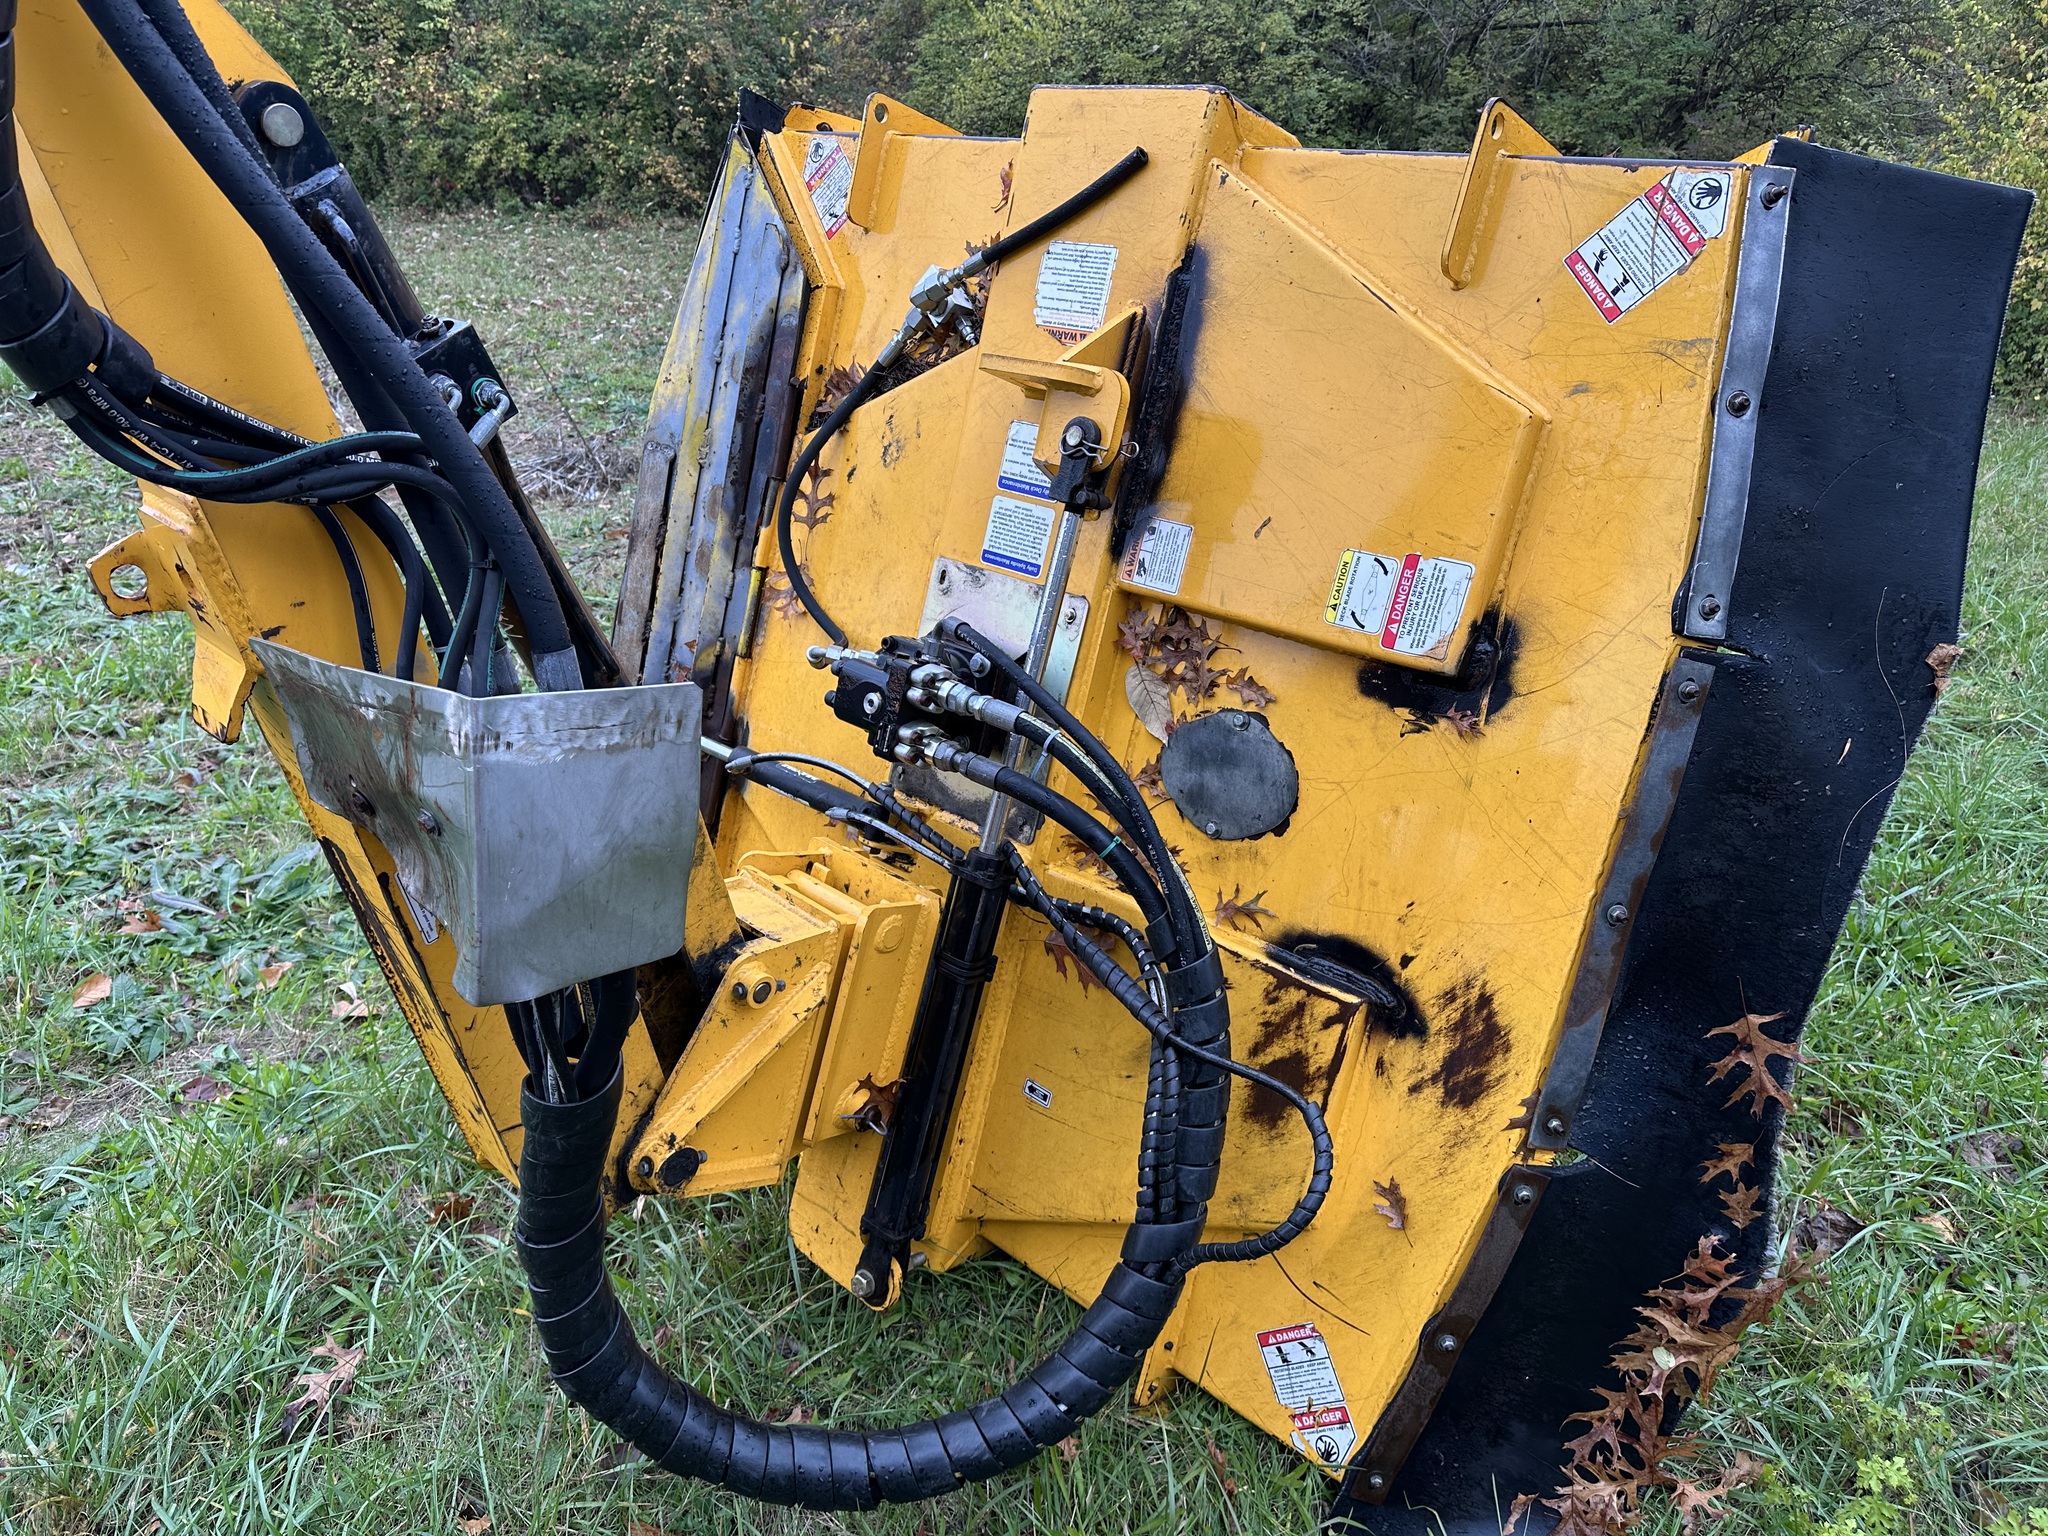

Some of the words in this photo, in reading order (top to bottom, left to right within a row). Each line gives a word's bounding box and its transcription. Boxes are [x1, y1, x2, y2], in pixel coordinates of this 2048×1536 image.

[1652, 190, 1691, 236] DANGER
[1682, 202, 1690, 212] AND
[1688, 210, 1700, 224] HANDS
[1697, 222, 1708, 234] KEEP
[1603, 232, 1613, 245] AWAY
[1610, 243, 1620, 255] KEEP
[1620, 255, 1633, 271] BLADES
[1573, 261, 1606, 301] DANGER
[1630, 269, 1646, 288] ROTATING
[85, 387, 110, 411] MPa
[168, 379, 206, 403] Parker
[209, 399, 245, 420] TOUGH
[246, 416, 275, 433] COVER
[129, 425, 149, 443] WP
[1001, 477, 1030, 490] Maintenance
[1030, 485, 1042, 493] Deck
[983, 552, 1010, 565] Maintenance
[1010, 560, 1026, 569] Spindle
[1026, 564, 1037, 573] Daily
[1332, 560, 1349, 601] CAUTION
[1338, 605, 1347, 621] DECK
[1343, 585, 1353, 605] BLADE
[1348, 555, 1361, 585] ROTATION
[1410, 567, 1424, 597] SERIOUS
[1391, 568, 1414, 619] DANGER
[1400, 598, 1414, 629] PREVENT
[1405, 612, 1417, 636] INJURY
[1413, 600, 1421, 611] OR
[1408, 637, 1416, 648] When
[1412, 617, 1422, 636] changing
[1425, 580, 1433, 595] always
[1397, 629, 1405, 639] TO
[1147, 842, 1169, 893] HANSA-FLEX
[1200, 923, 1212, 945] MSHA
[1275, 1327, 1312, 1341] DANGER
